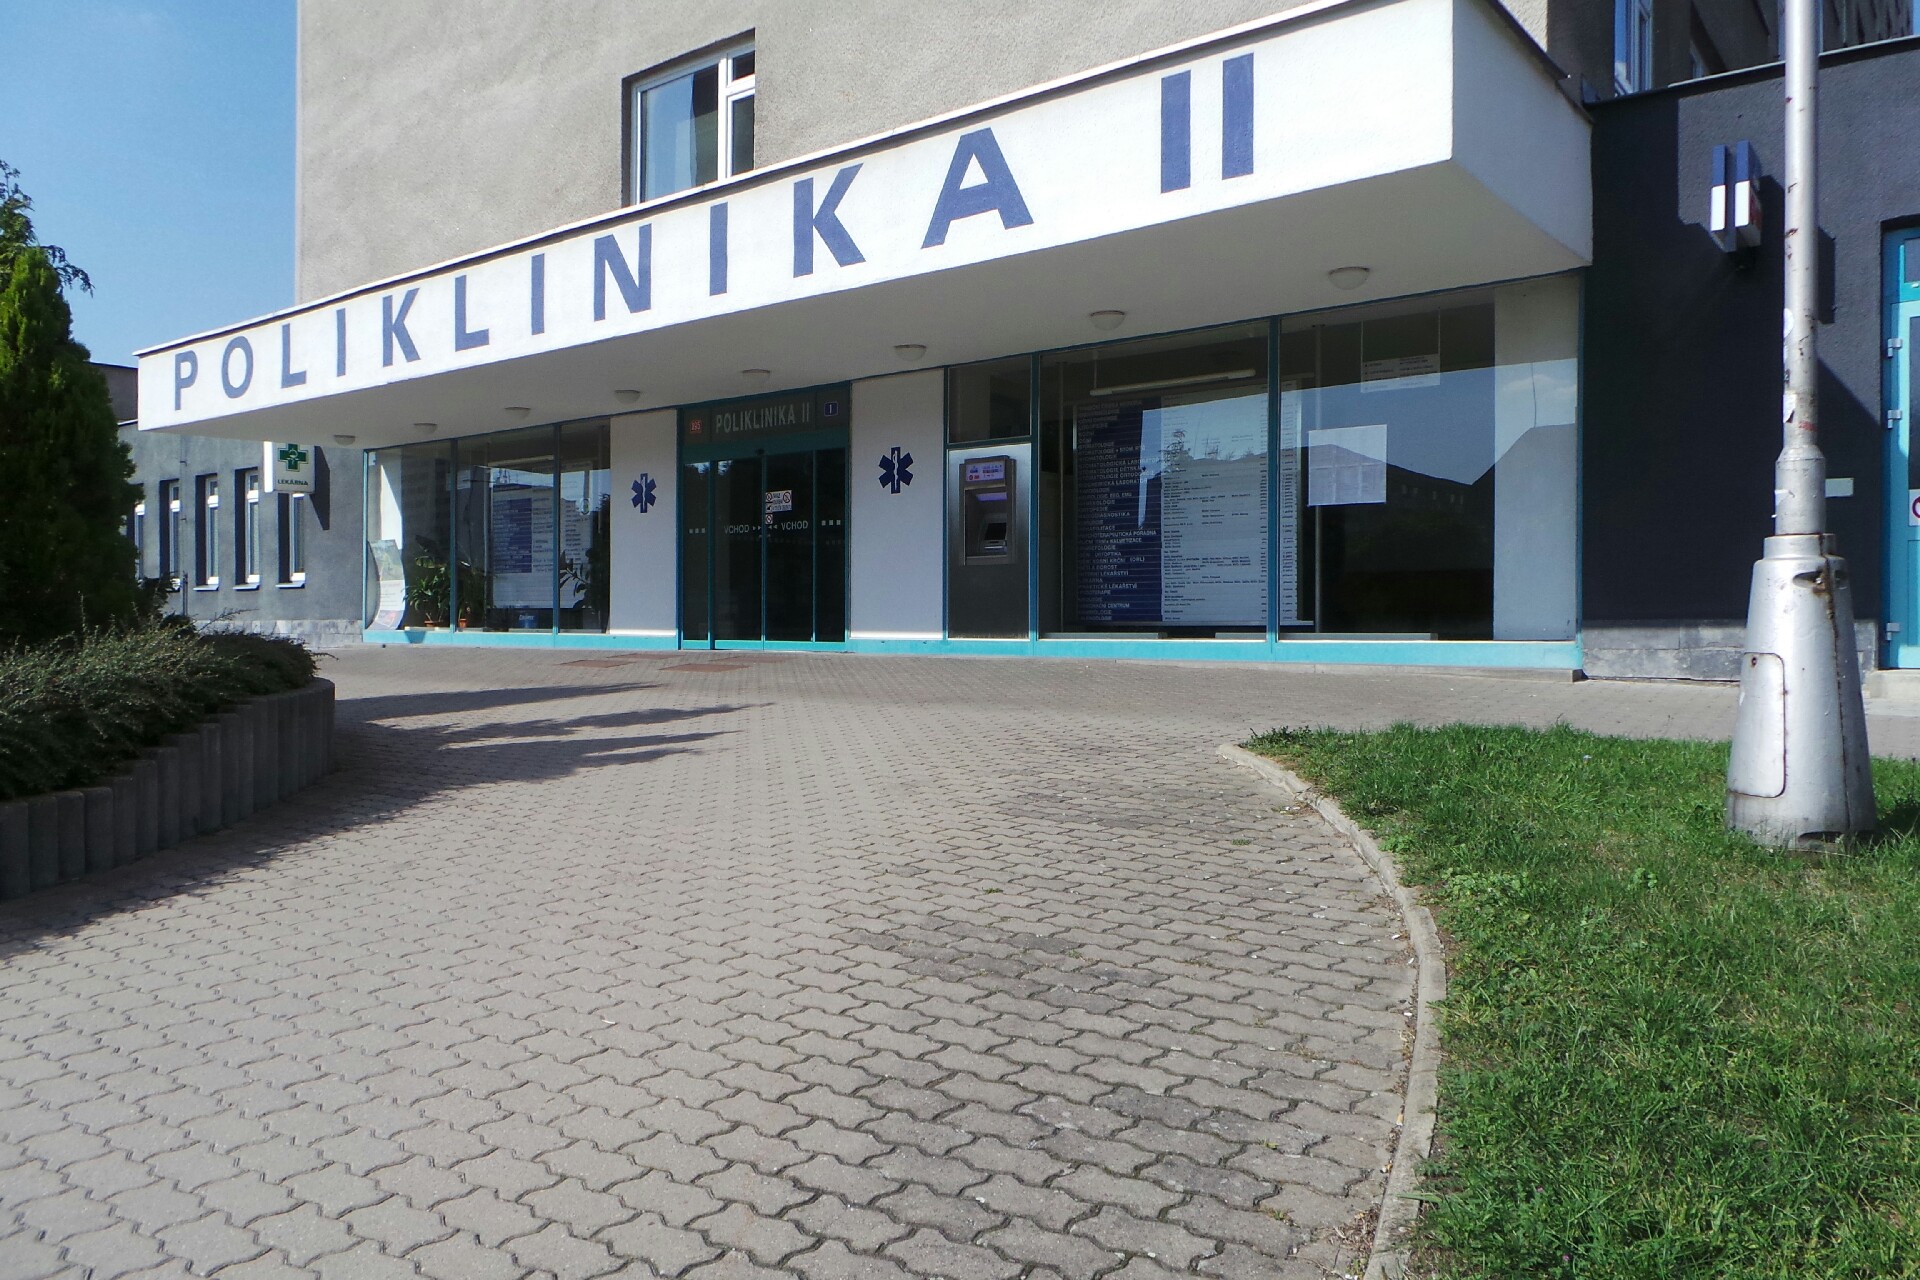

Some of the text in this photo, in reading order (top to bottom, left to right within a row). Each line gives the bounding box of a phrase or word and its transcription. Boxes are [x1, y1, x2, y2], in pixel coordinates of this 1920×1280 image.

[174, 52, 1255, 427] POLIKLINIKA II
[716, 402, 810, 433] POLIKLINIKA II
[724, 520, 809, 535] VCHOD VCHOD
